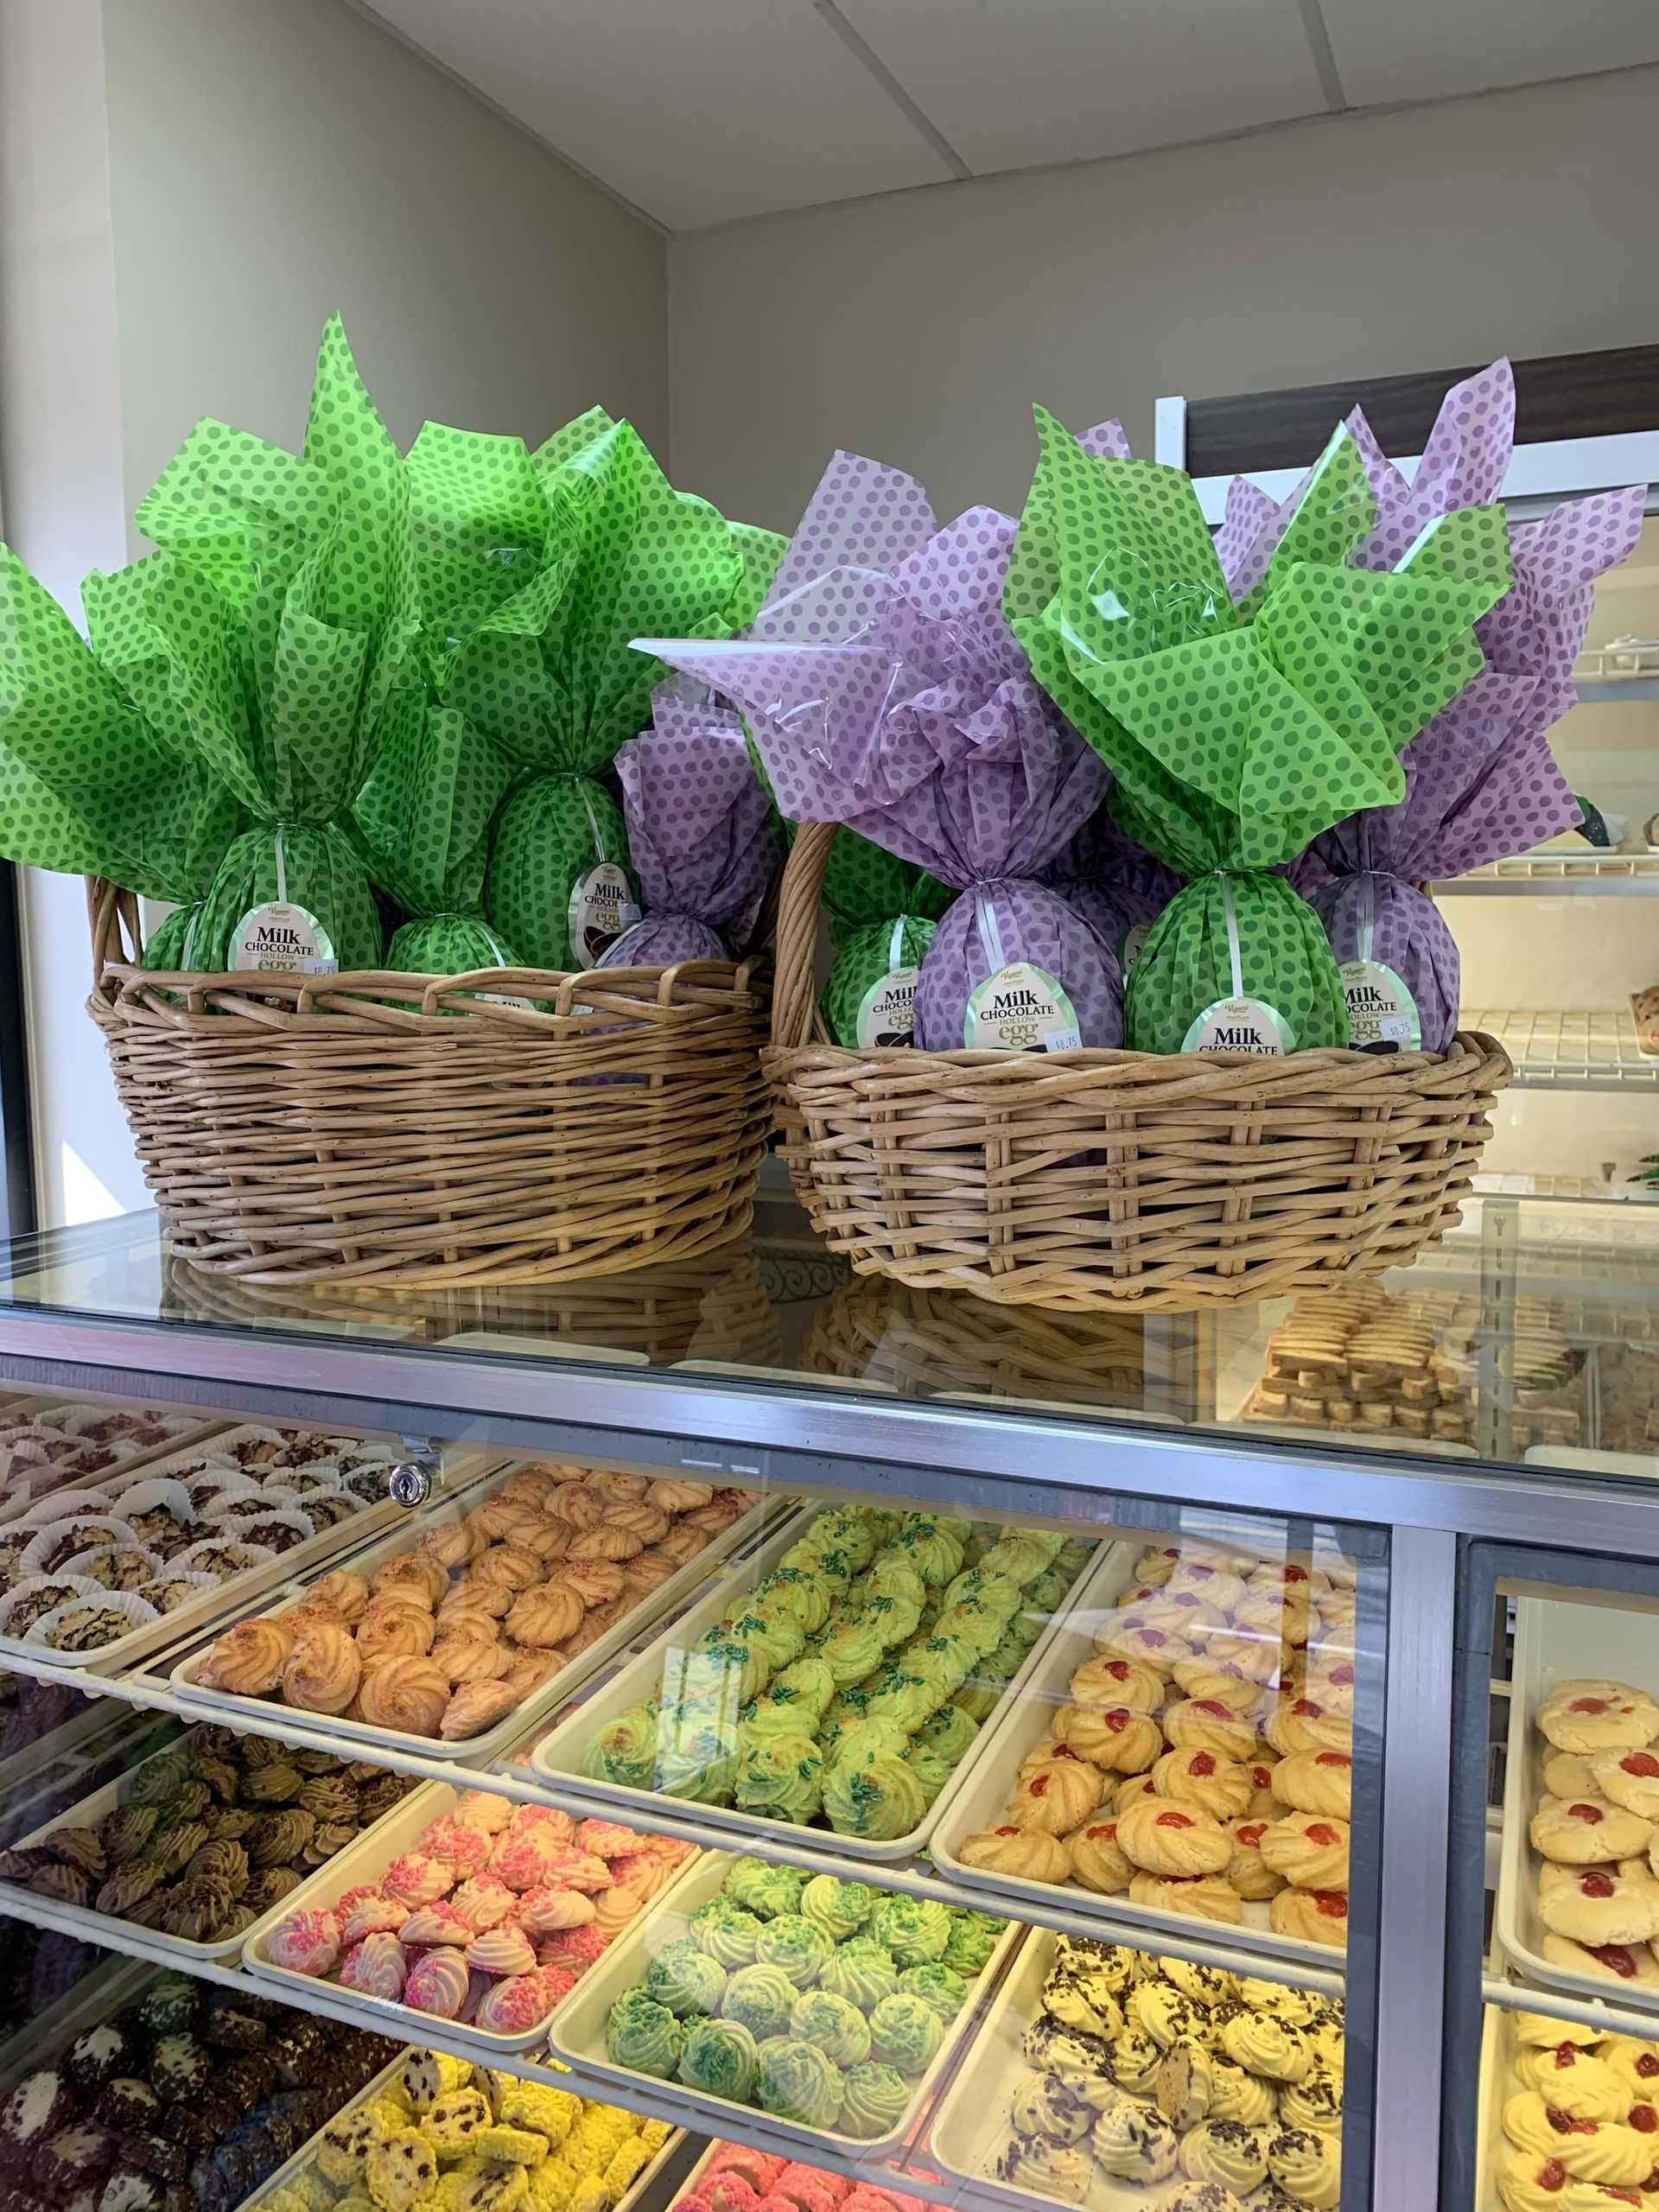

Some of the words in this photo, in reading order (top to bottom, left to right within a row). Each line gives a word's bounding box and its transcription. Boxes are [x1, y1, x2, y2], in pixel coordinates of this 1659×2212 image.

[594, 882, 626, 900] Milk
[584, 894, 628, 908] CHOCOL
[595, 912, 620, 931] egg
[257, 926, 301, 945] Milk
[245, 942, 314, 956] CHOCOLATE
[873, 999, 912, 1013] CHOCO
[994, 989, 1040, 1009] Milk
[889, 1007, 914, 1015] HOLLO
[981, 1006, 1054, 1020] CHOCOLATE
[1346, 1002, 1397, 1014] OCOLATE
[1000, 1016, 1036, 1026] HOLLOW
[1350, 1013, 1380, 1021] OLLOW
[999, 1023, 1039, 1046] egg
[1213, 1027, 1264, 1045] Milk
[1389, 1021, 1410, 1037] $8.75
[1056, 1036, 1077, 1051] $8.75
